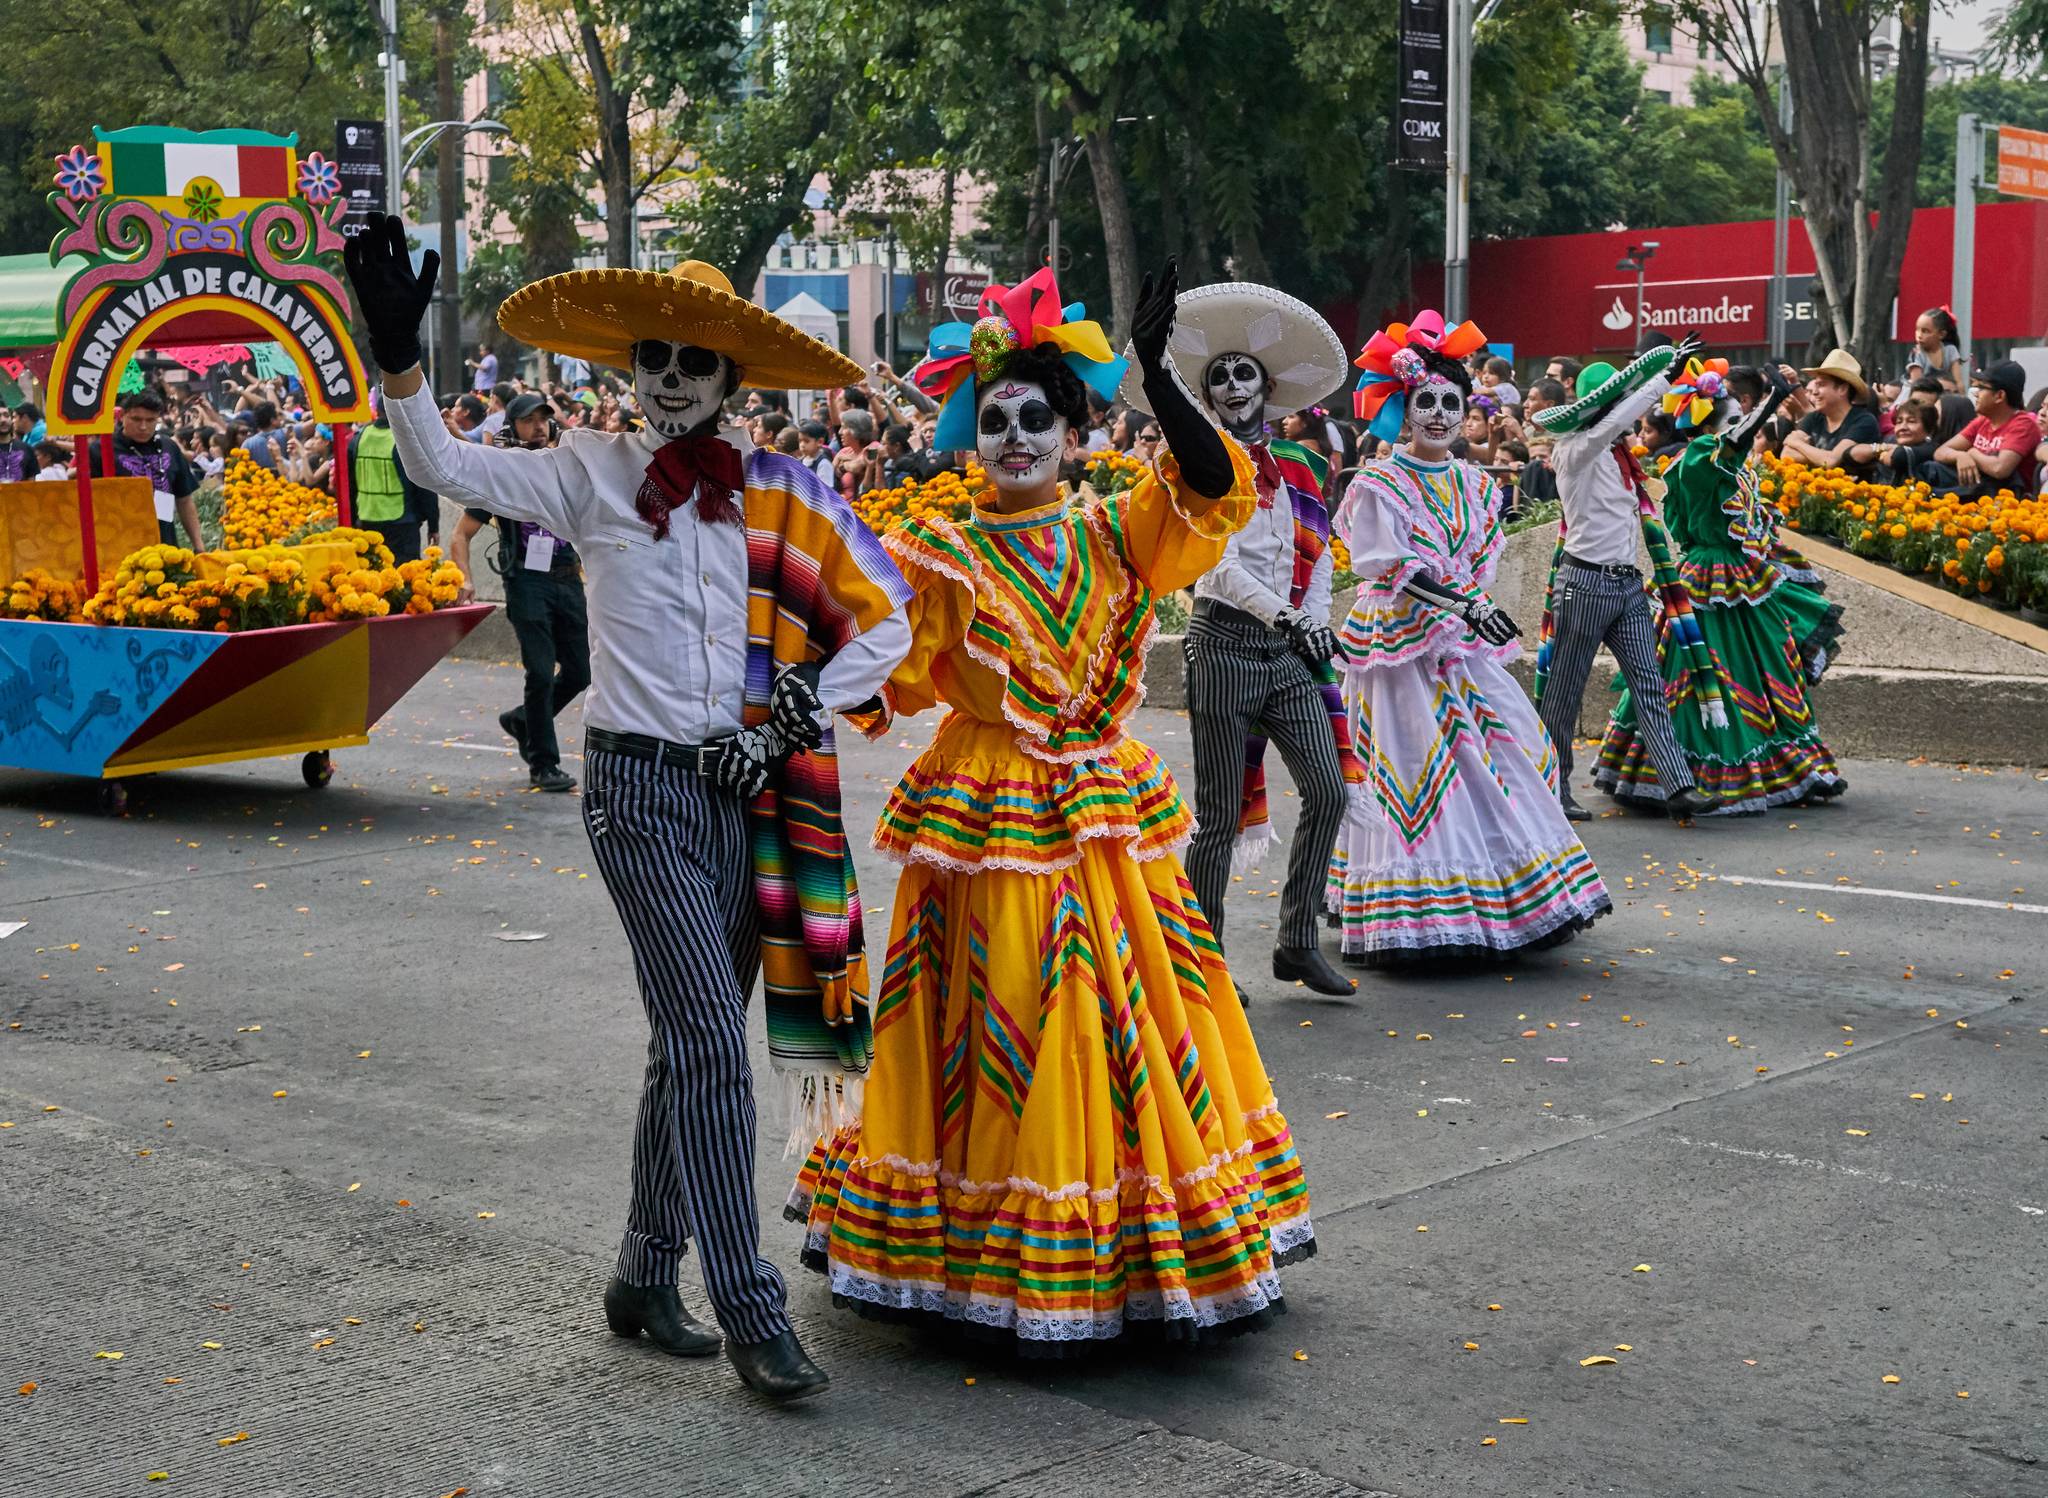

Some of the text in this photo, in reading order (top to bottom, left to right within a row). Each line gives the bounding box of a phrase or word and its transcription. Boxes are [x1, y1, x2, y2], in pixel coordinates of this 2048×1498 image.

[1403, 119, 1441, 138] CDMX
[1639, 295, 1753, 327] Santander
[72, 267, 350, 406] CARNAVAL DE CALAVERAS
